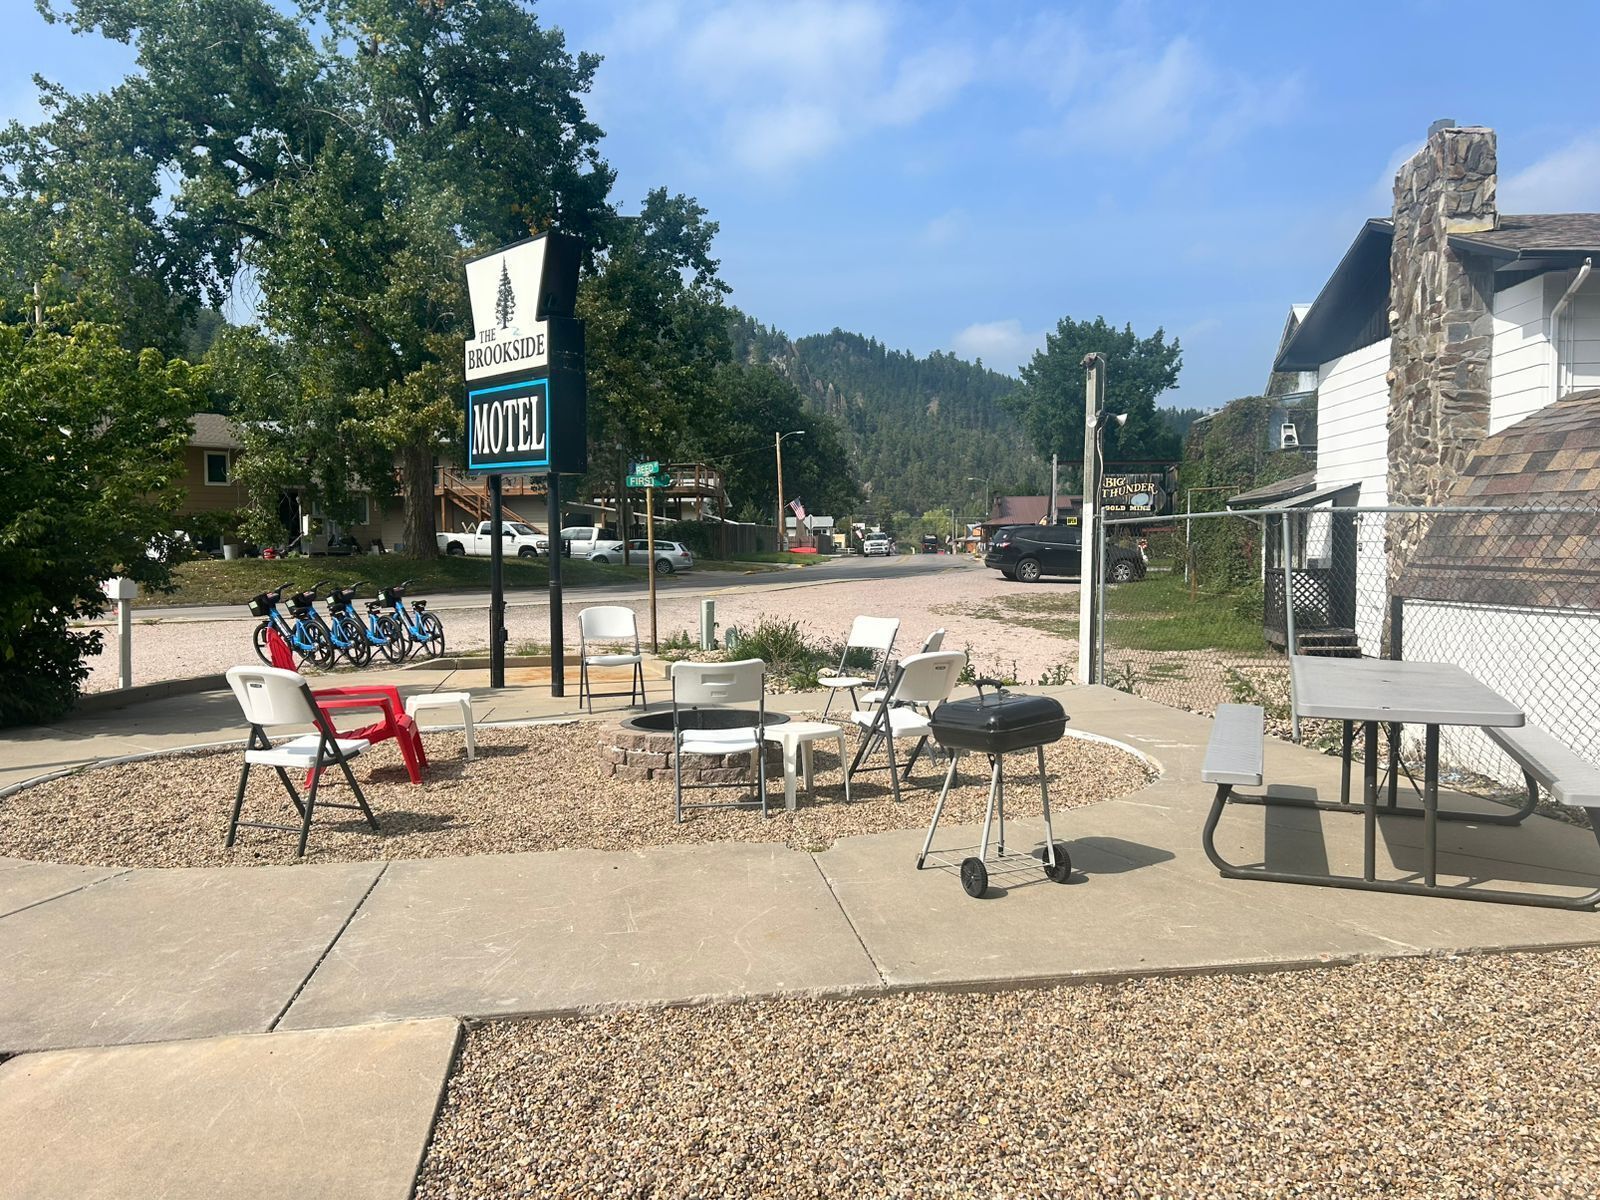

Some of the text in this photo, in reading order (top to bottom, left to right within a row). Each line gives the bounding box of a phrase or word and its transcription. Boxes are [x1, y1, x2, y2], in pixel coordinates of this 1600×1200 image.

[479, 328, 496, 344] THE
[468, 334, 545, 370] BROOKSIDE
[472, 396, 545, 455] MOTEL
[636, 463, 654, 475] REED
[630, 477, 655, 487] FIRST
[1103, 478, 1126, 487] BIG
[1102, 483, 1158, 497] THUNDER
